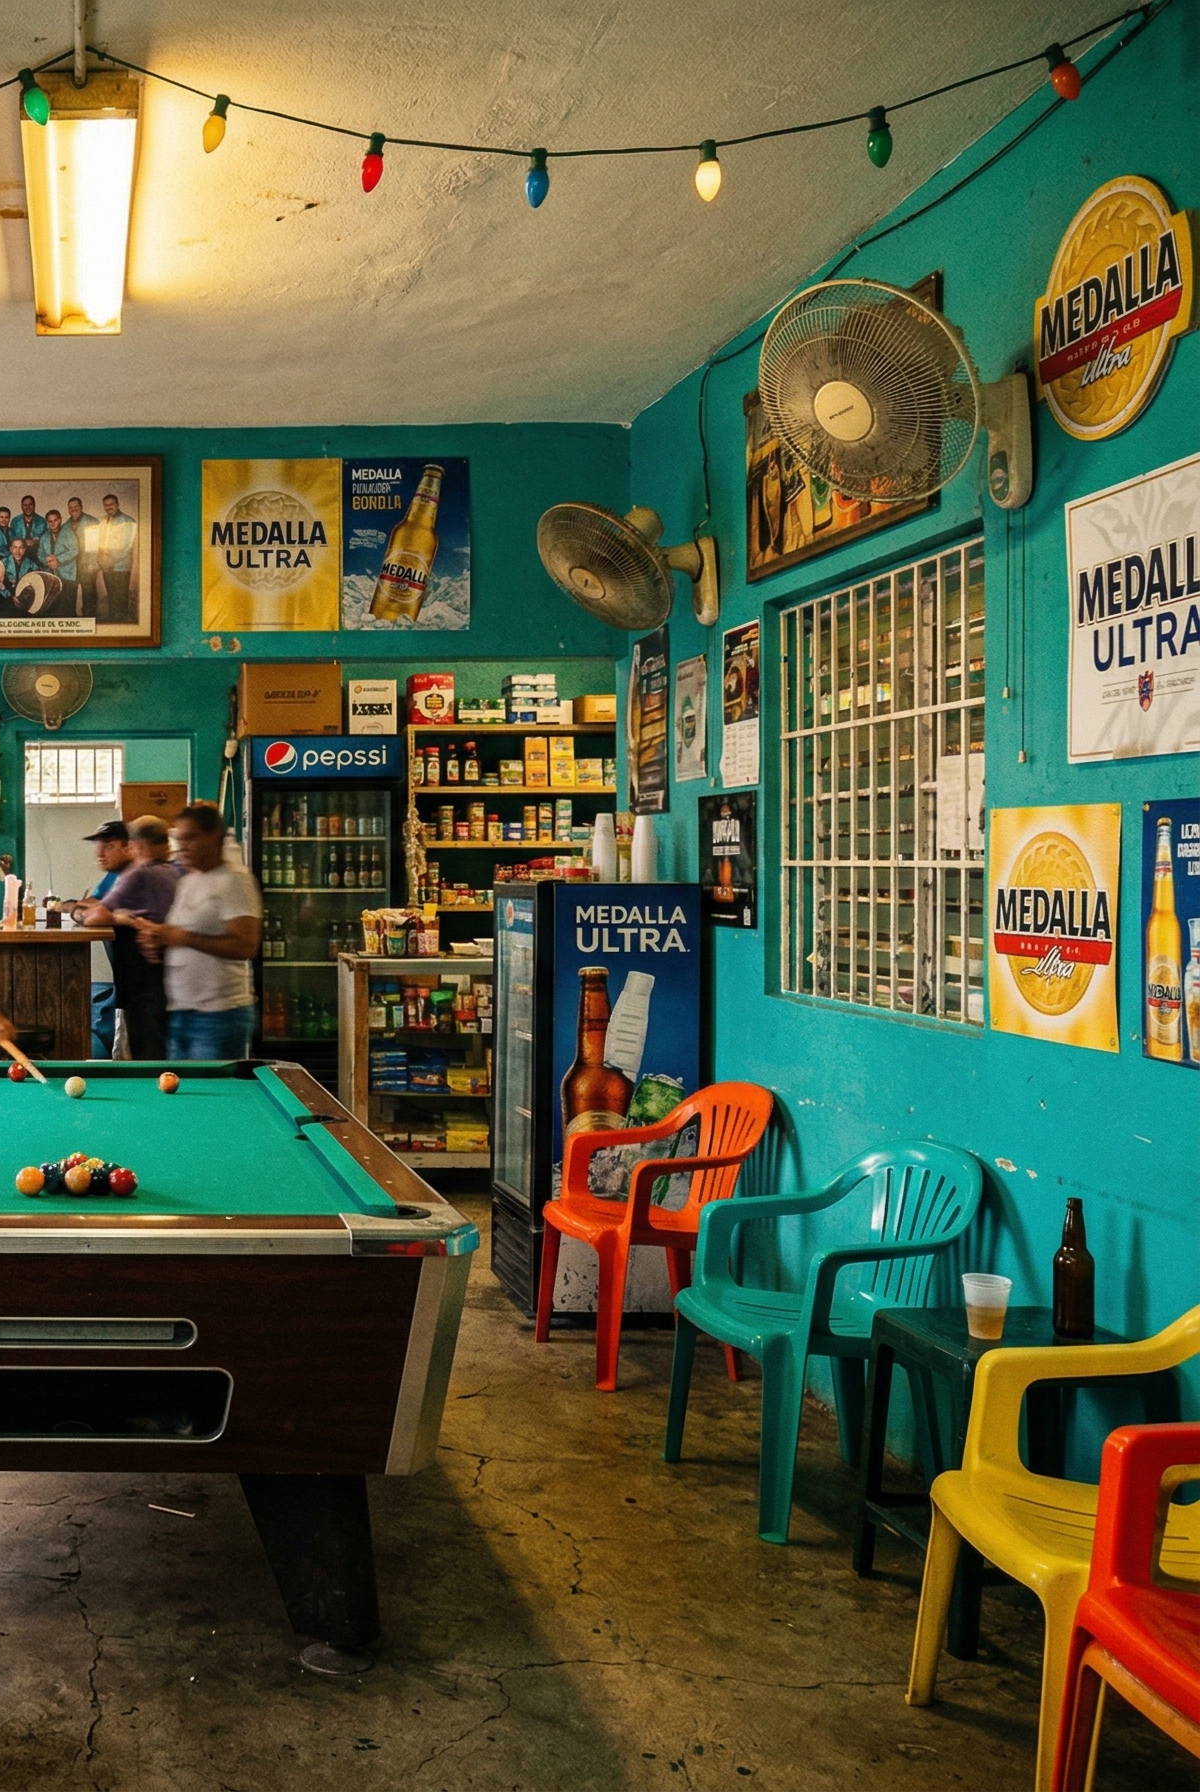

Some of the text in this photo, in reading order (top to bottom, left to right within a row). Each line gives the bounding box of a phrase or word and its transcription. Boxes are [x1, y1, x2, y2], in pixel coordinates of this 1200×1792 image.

[1039, 228, 1182, 362] MEDALLA
[352, 468, 402, 480] MEDALLA
[211, 521, 327, 546] MEDALLA
[226, 549, 312, 569] ULTRA
[1078, 534, 1200, 627] MEDALL
[1093, 604, 1200, 672] ULTRA
[302, 745, 387, 771] pepssi
[575, 905, 687, 924] MEDALLA
[995, 888, 1112, 940] MEDALLA
